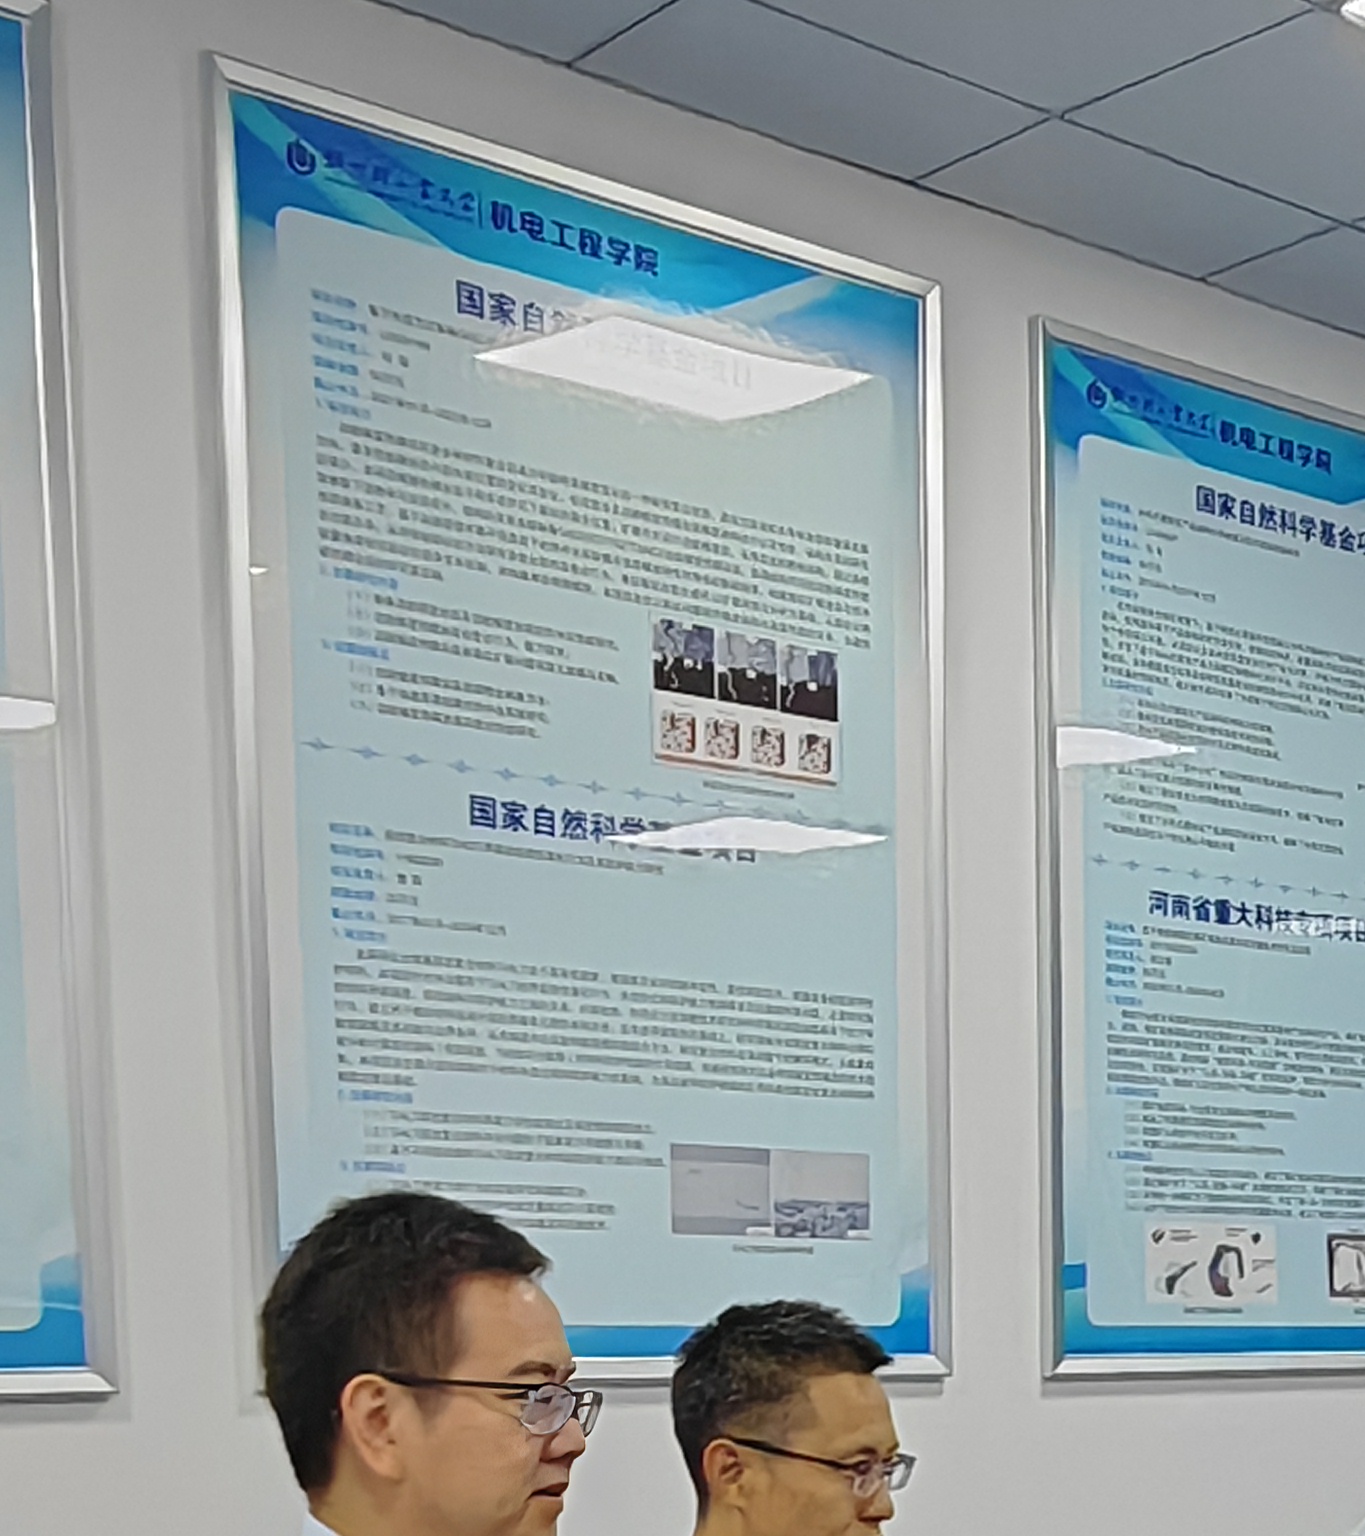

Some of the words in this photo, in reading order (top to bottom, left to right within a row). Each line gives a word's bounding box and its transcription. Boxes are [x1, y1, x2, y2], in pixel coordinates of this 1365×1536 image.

[490, 200, 660, 277] 机电工程学院
